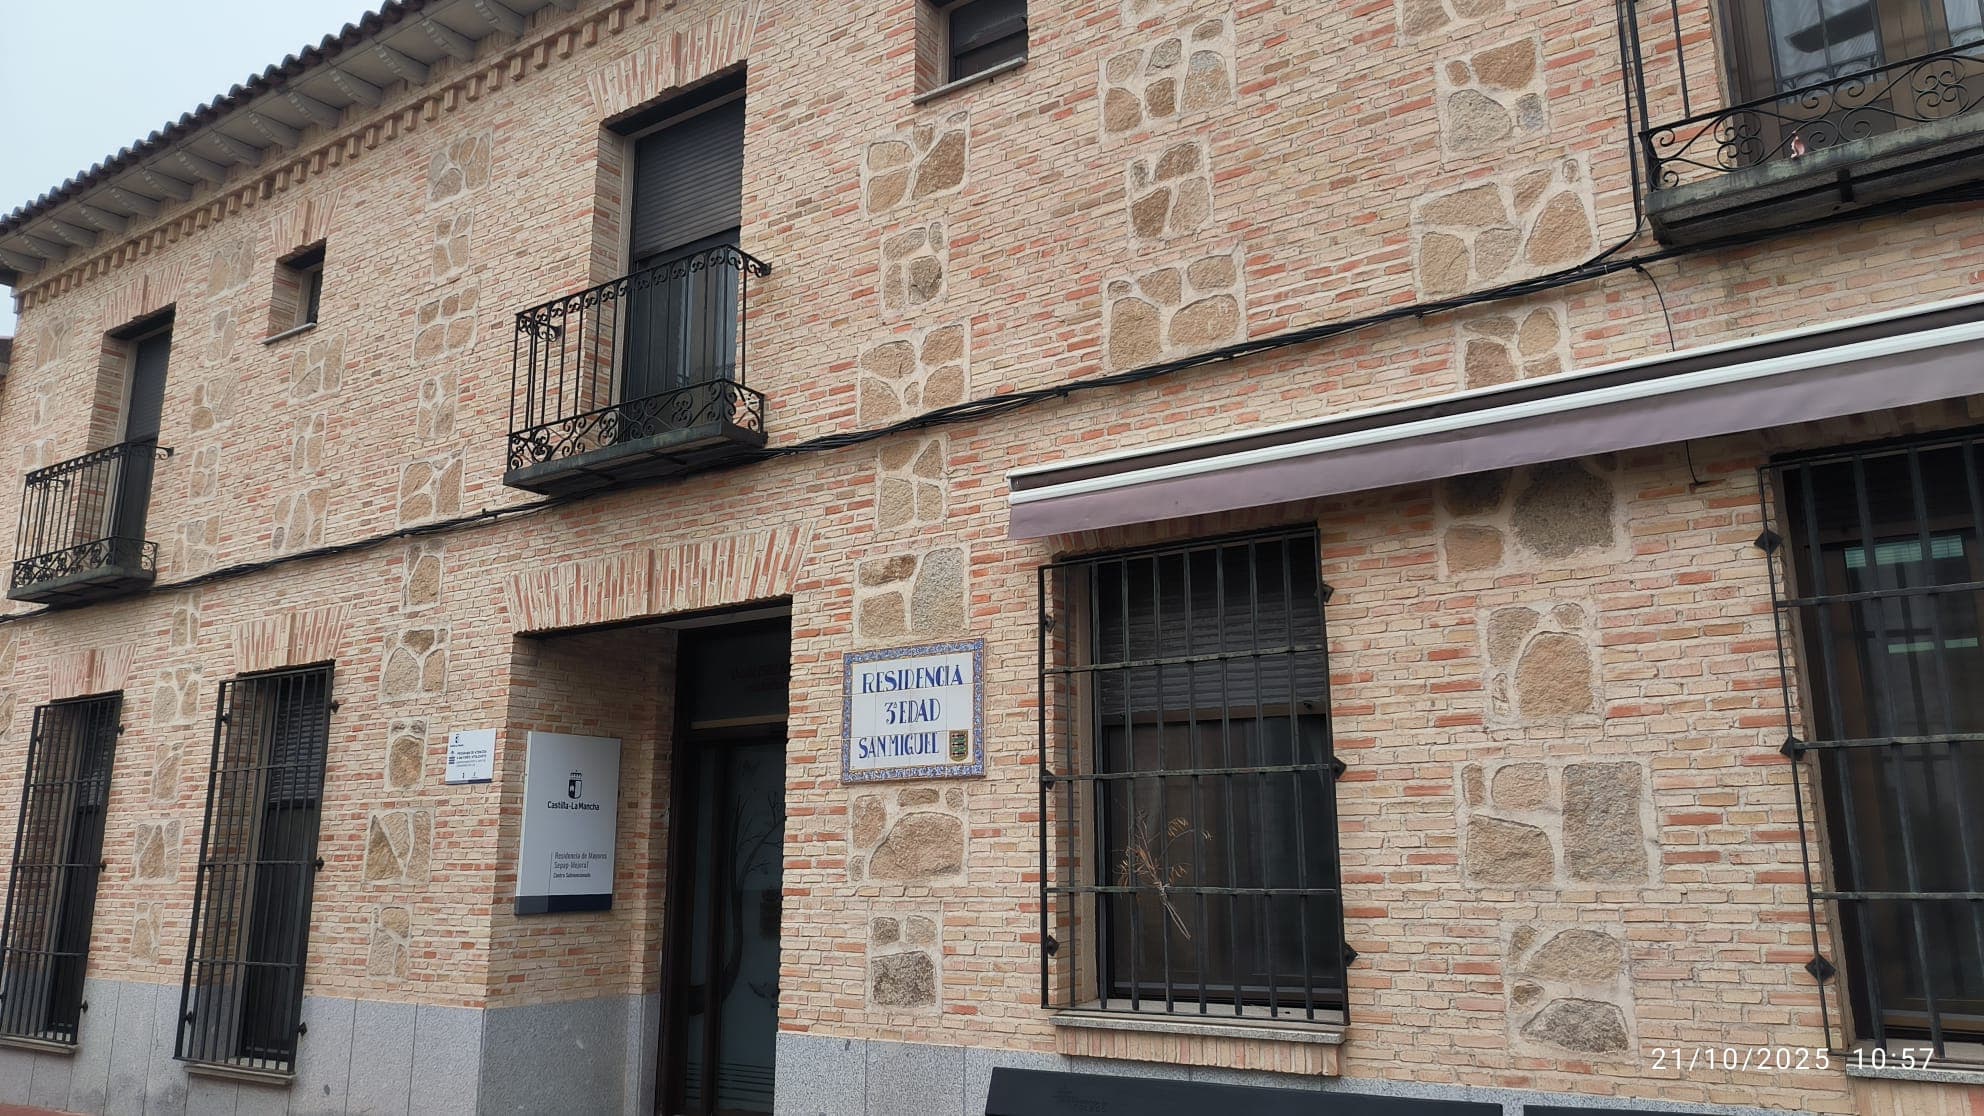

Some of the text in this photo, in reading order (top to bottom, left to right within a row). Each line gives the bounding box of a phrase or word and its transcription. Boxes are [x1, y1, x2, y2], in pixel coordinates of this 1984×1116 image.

[863, 664, 964, 694] RESIDENCIA
[899, 698, 941, 724] EDAD
[858, 731, 939, 759] SAN MIGUEL
[578, 802, 600, 811] Mancha
